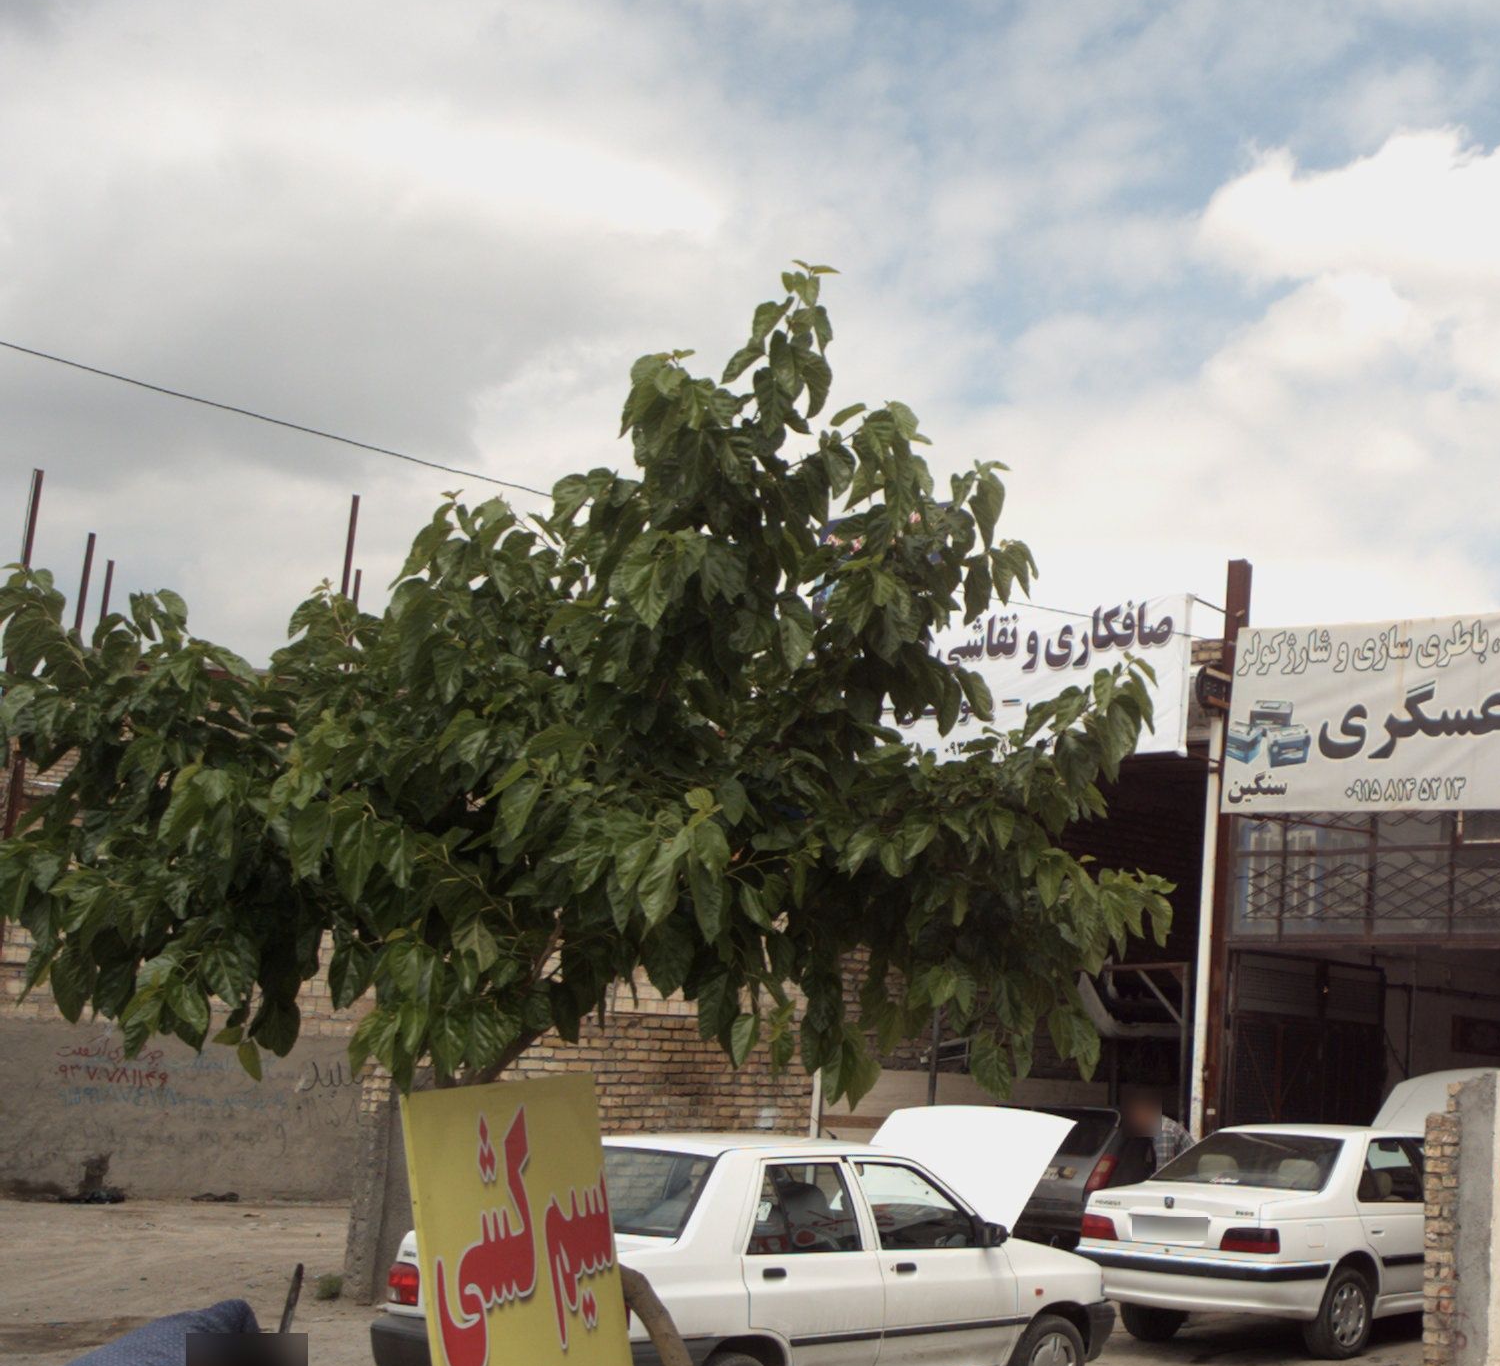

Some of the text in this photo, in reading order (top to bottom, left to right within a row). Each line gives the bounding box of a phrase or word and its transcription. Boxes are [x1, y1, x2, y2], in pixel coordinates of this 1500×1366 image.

[1022, 629, 1040, 672] و
[1044, 600, 1174, 671] صافکاری
[1236, 630, 1287, 676] کولر
[1281, 629, 1332, 675] شارژ
[1333, 641, 1349, 673] و
[1352, 624, 1413, 672] سازی
[1416, 619, 1489, 669] باطری
[1227, 771, 1288, 804] سنگین
[545, 1171, 615, 1351] سیم
